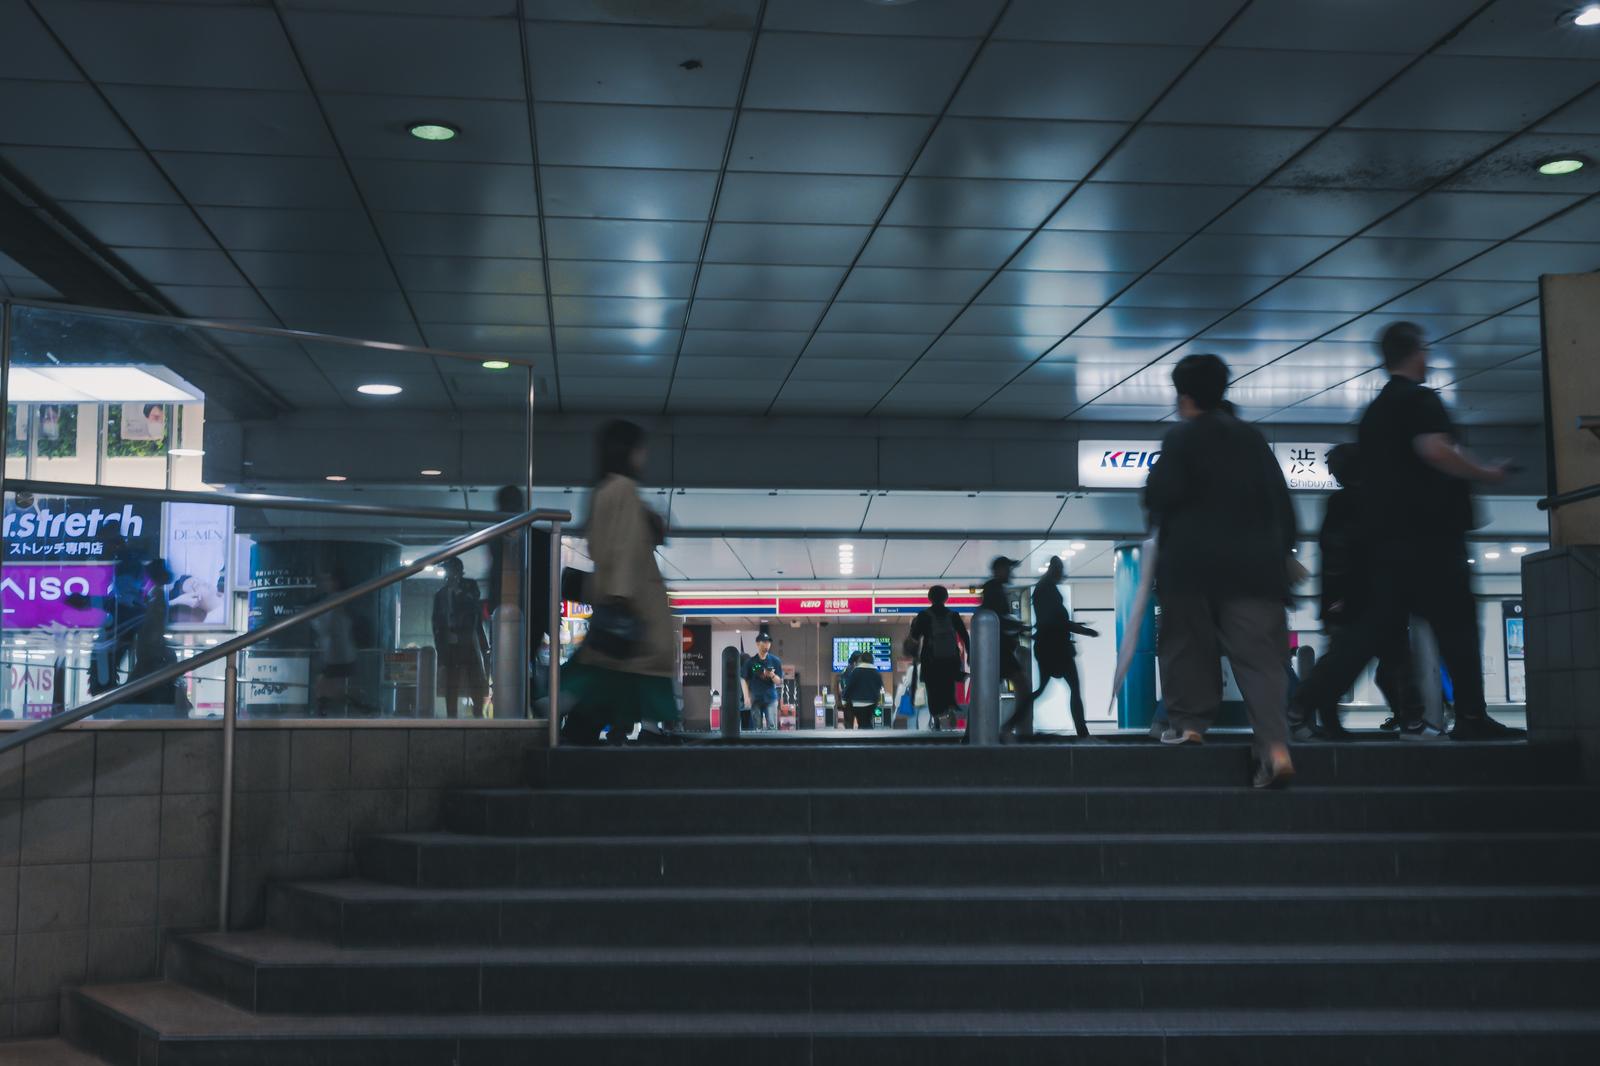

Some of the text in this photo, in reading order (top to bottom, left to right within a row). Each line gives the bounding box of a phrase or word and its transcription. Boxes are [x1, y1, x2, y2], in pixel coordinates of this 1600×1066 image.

[1289, 448, 1331, 475] 渋
[1290, 479, 1334, 489] Shibuya
[10, 542, 104, 555] ストレッチ専門店
[800, 600, 822, 608] KEIO
